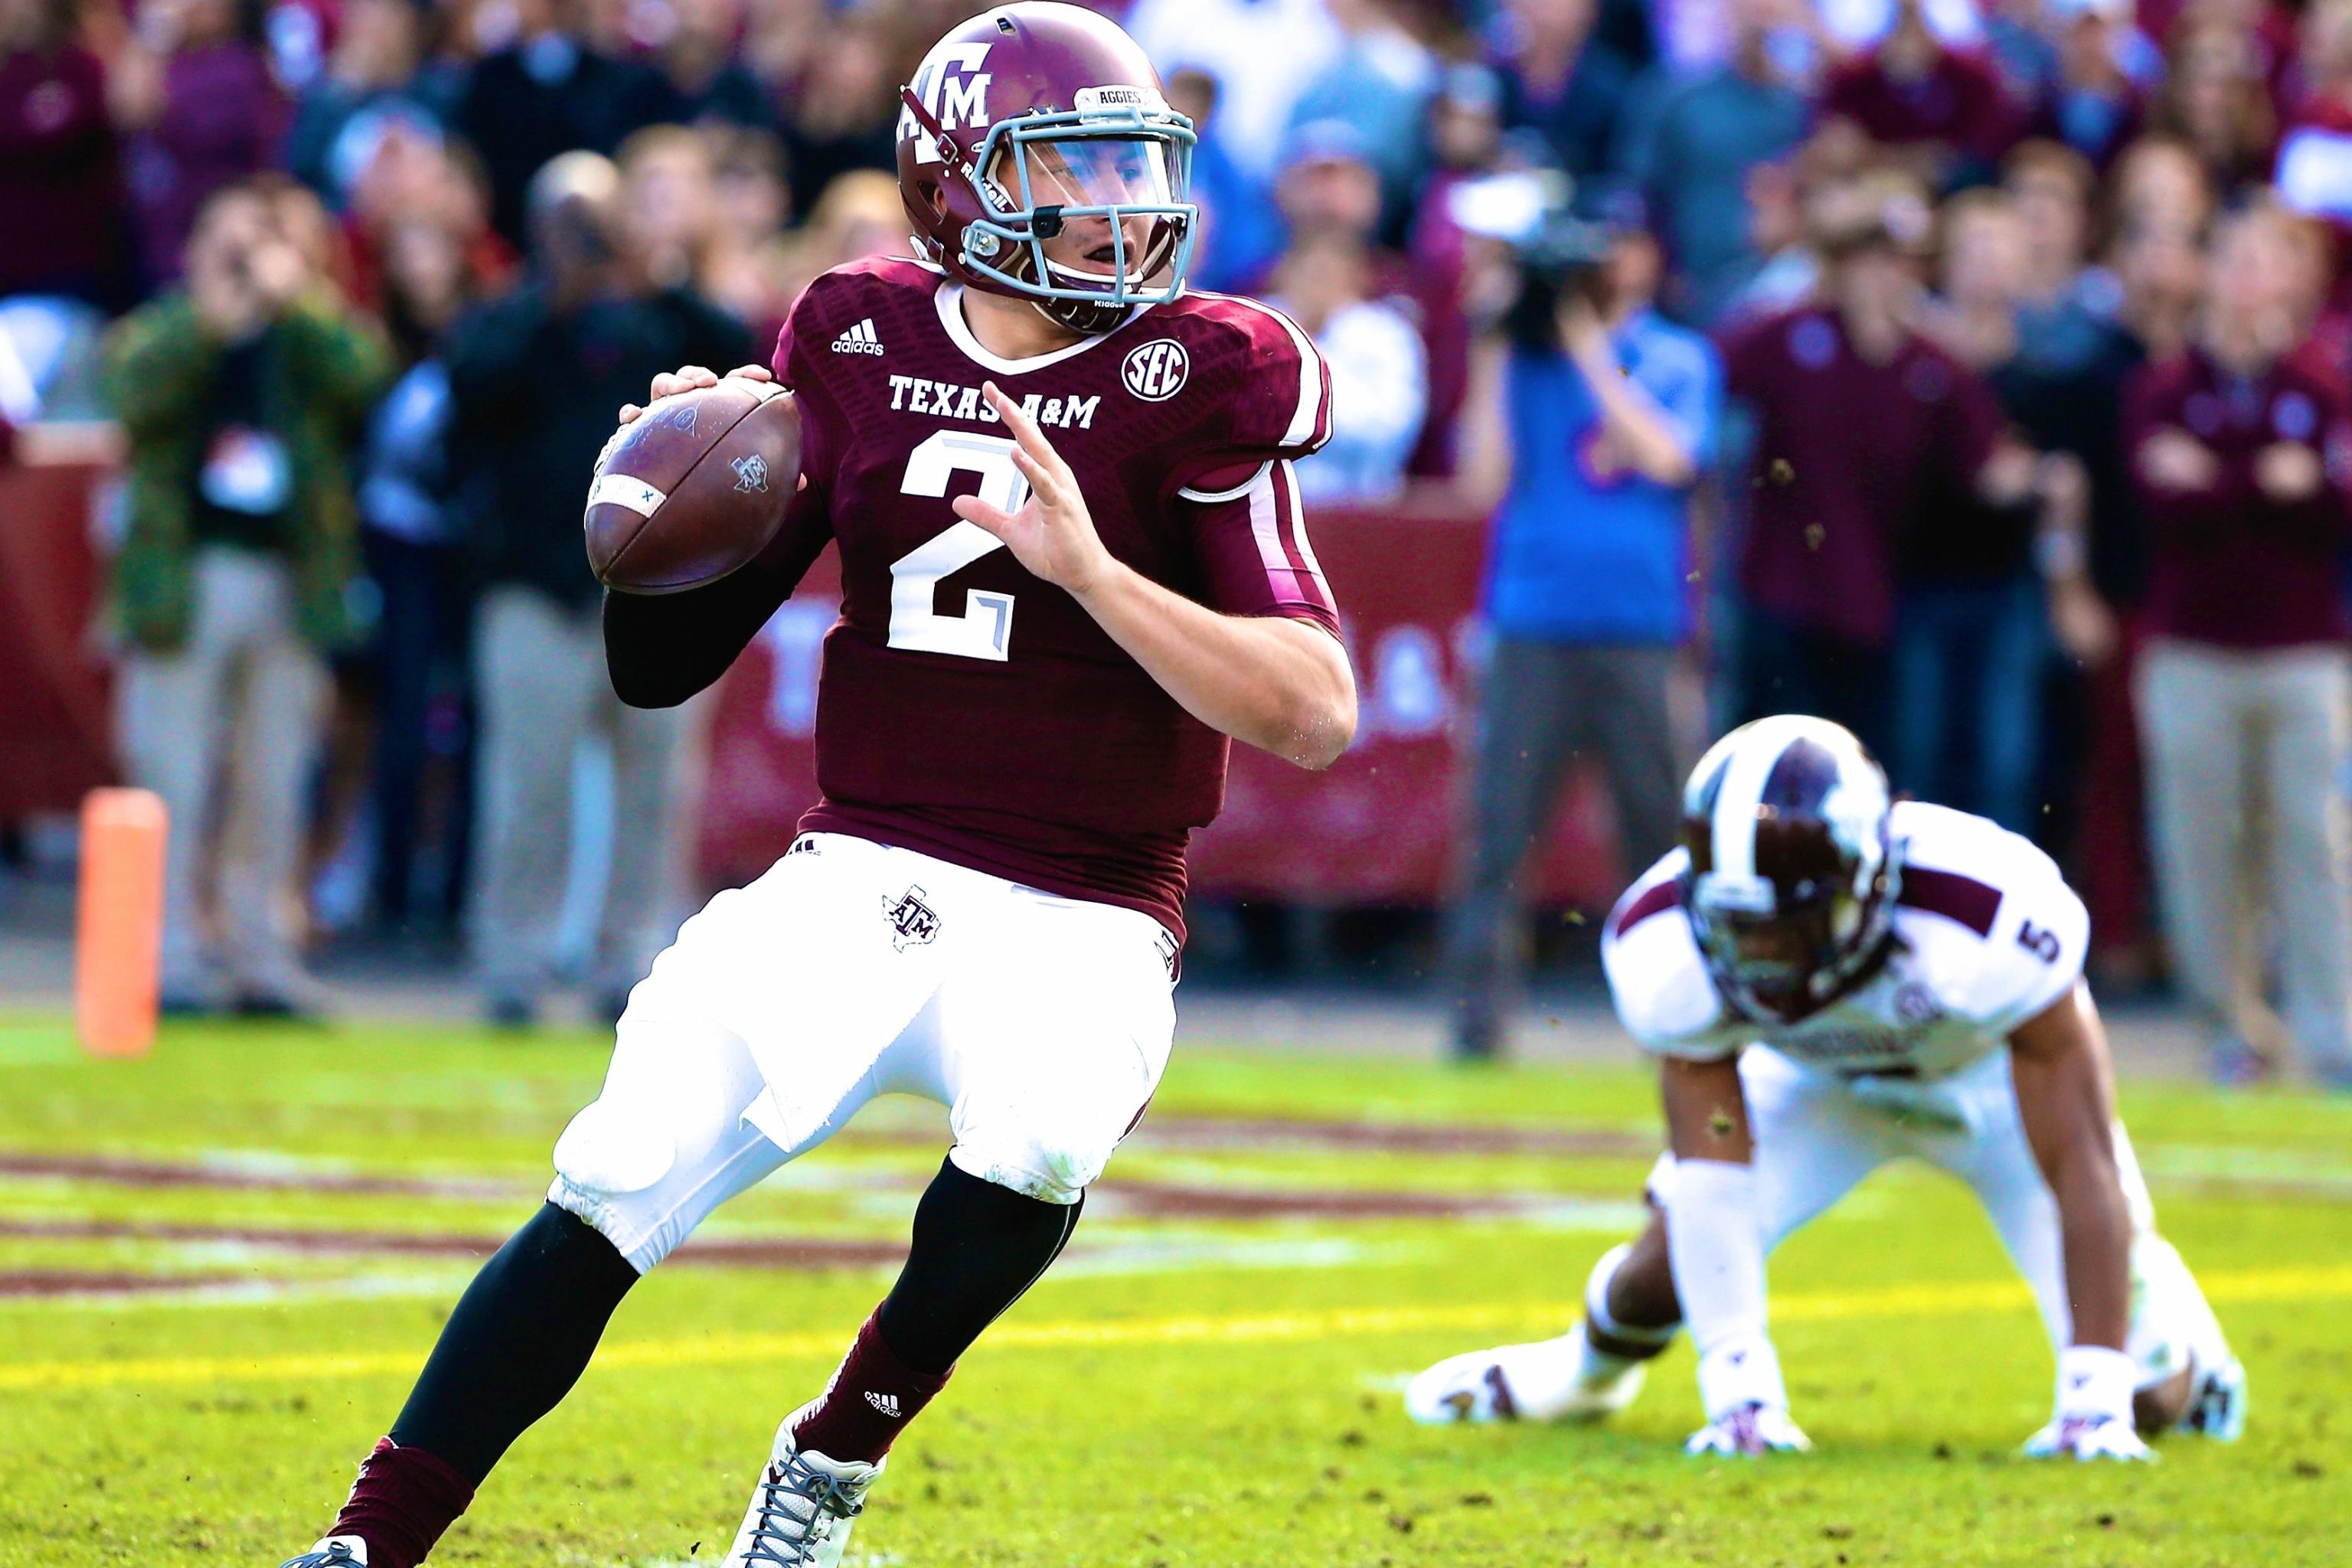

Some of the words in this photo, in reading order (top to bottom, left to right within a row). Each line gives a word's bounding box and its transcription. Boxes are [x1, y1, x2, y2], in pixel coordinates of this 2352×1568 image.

[1099, 90, 1141, 104] AGGIES
[831, 340, 884, 356] adidas
[1128, 344, 1184, 397] SEC
[887, 429, 1031, 662] 2
[2017, 919, 2060, 964] 5
[864, 1390, 902, 1418] adidas
